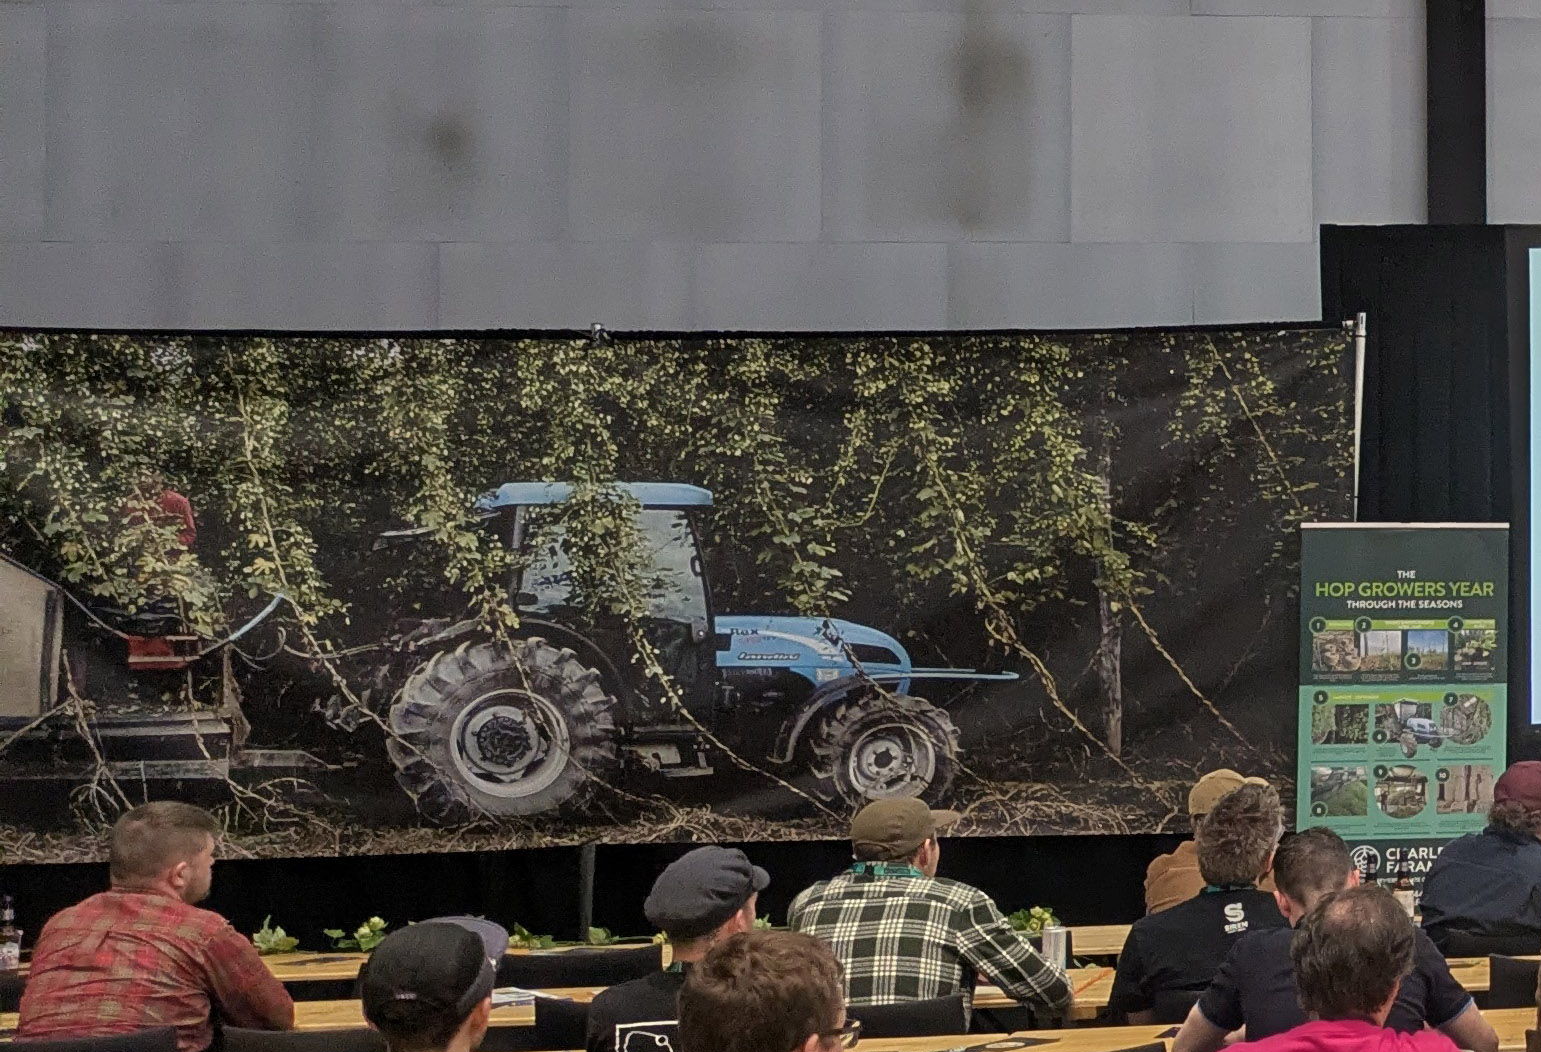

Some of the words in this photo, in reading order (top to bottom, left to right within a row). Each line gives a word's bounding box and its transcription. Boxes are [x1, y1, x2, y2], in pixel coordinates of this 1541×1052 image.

[1397, 570, 1416, 578] THE
[1315, 582, 1356, 597] HOP
[1358, 582, 1446, 597] GROWERS
[1449, 582, 1494, 597] YEAR
[1346, 600, 1396, 608] THROUGH
[1398, 600, 1416, 608] THE
[1418, 600, 1464, 608] SEASONS
